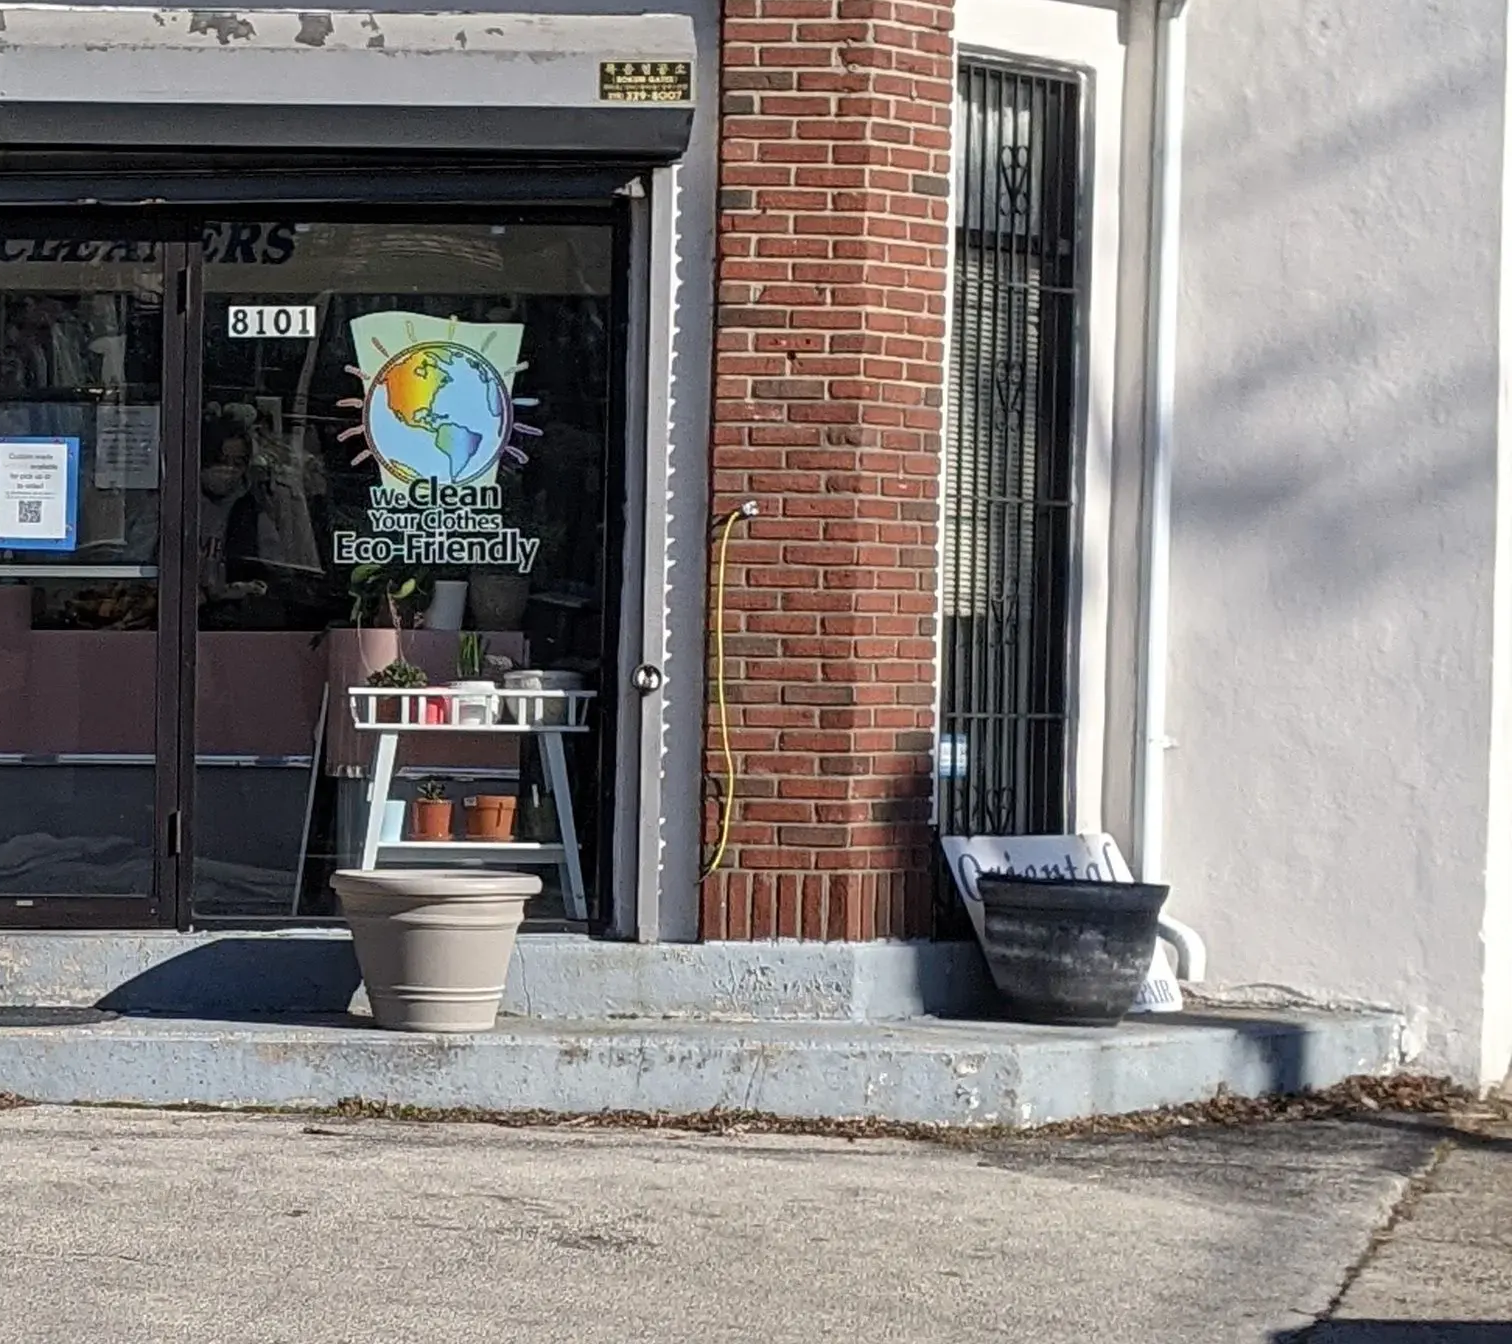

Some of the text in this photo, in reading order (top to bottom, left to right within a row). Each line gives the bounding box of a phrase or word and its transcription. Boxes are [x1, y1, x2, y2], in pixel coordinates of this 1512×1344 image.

[231, 307, 312, 336] 8101
[371, 475, 502, 508] We Clean
[368, 508, 503, 532] Your Clothes
[334, 529, 540, 573] Eco-Friendly
[1135, 979, 1175, 1005] PAIR
